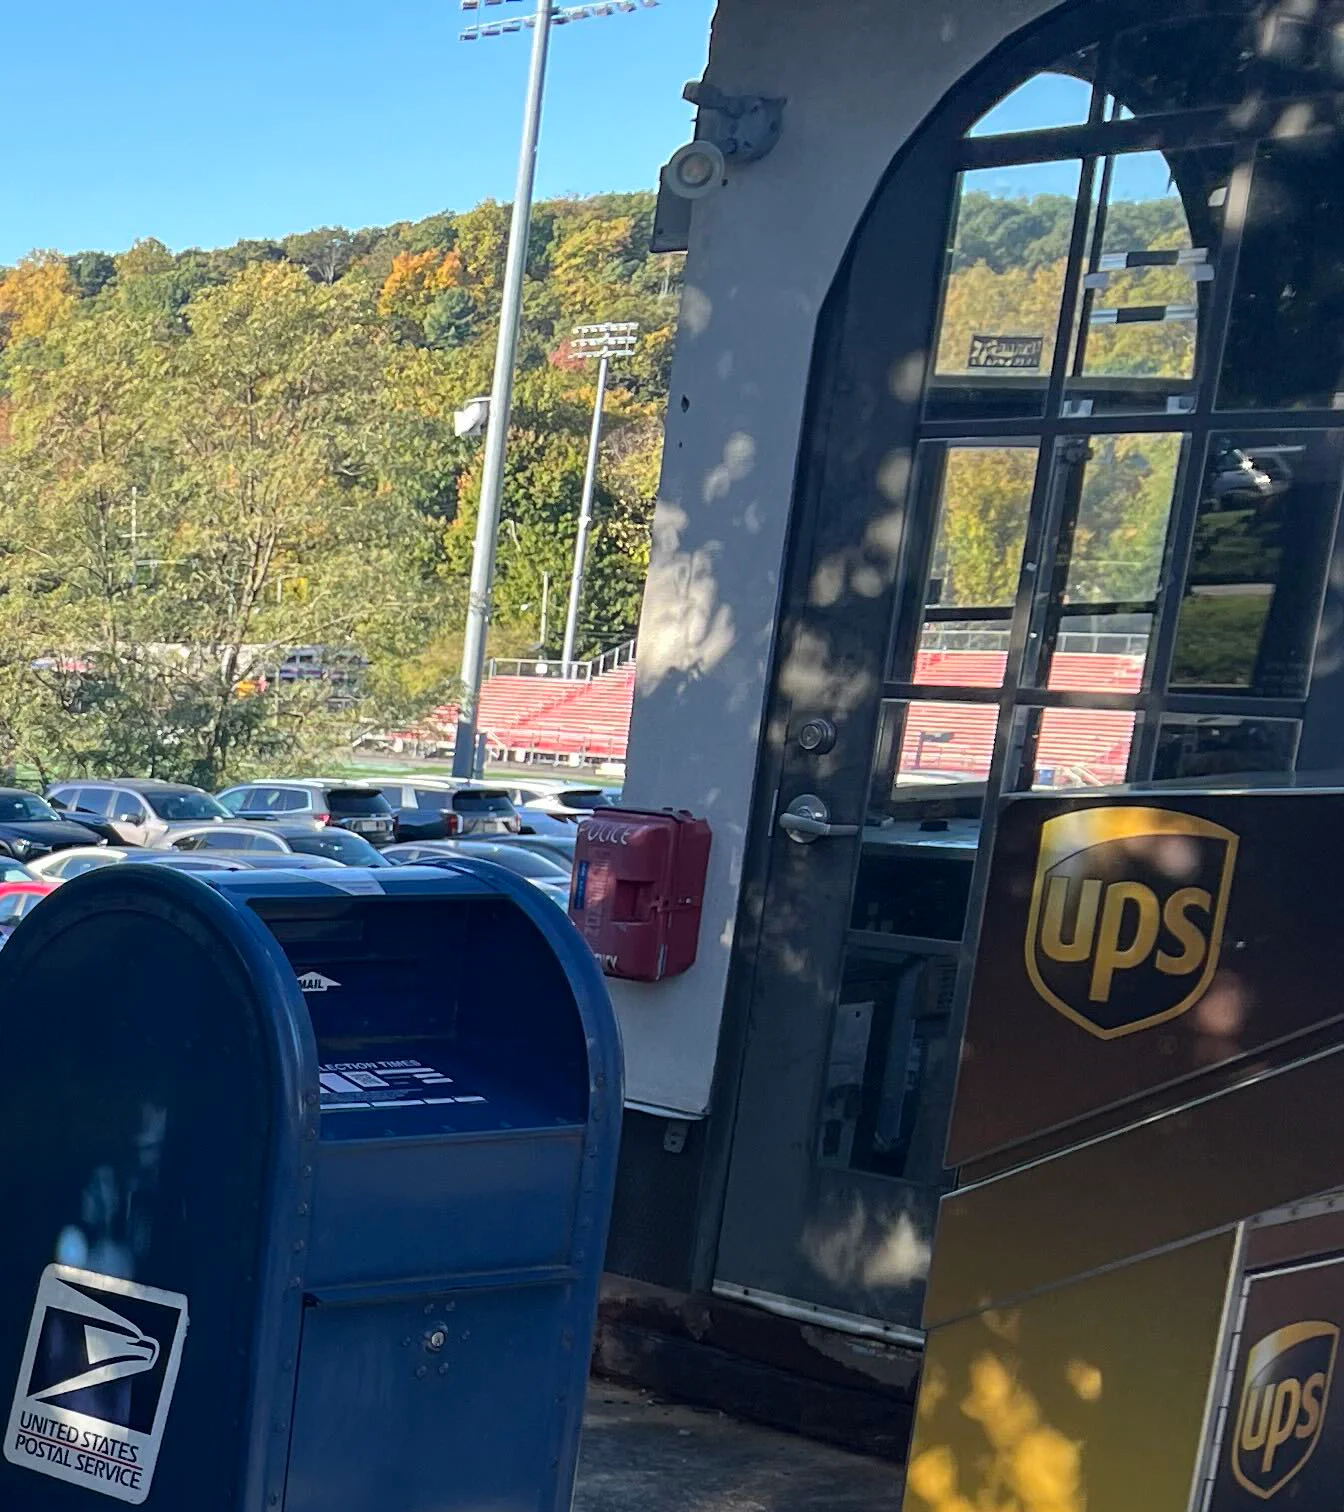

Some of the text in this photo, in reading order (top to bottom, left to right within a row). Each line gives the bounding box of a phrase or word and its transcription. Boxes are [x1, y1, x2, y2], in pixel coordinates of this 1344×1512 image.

[298, 979, 324, 989] MAIL
[319, 1060, 422, 1072] LECTION TIMES
[20, 1410, 140, 1464] UNITED STATES
[15, 1433, 143, 1491] POSTAL SERVICE
